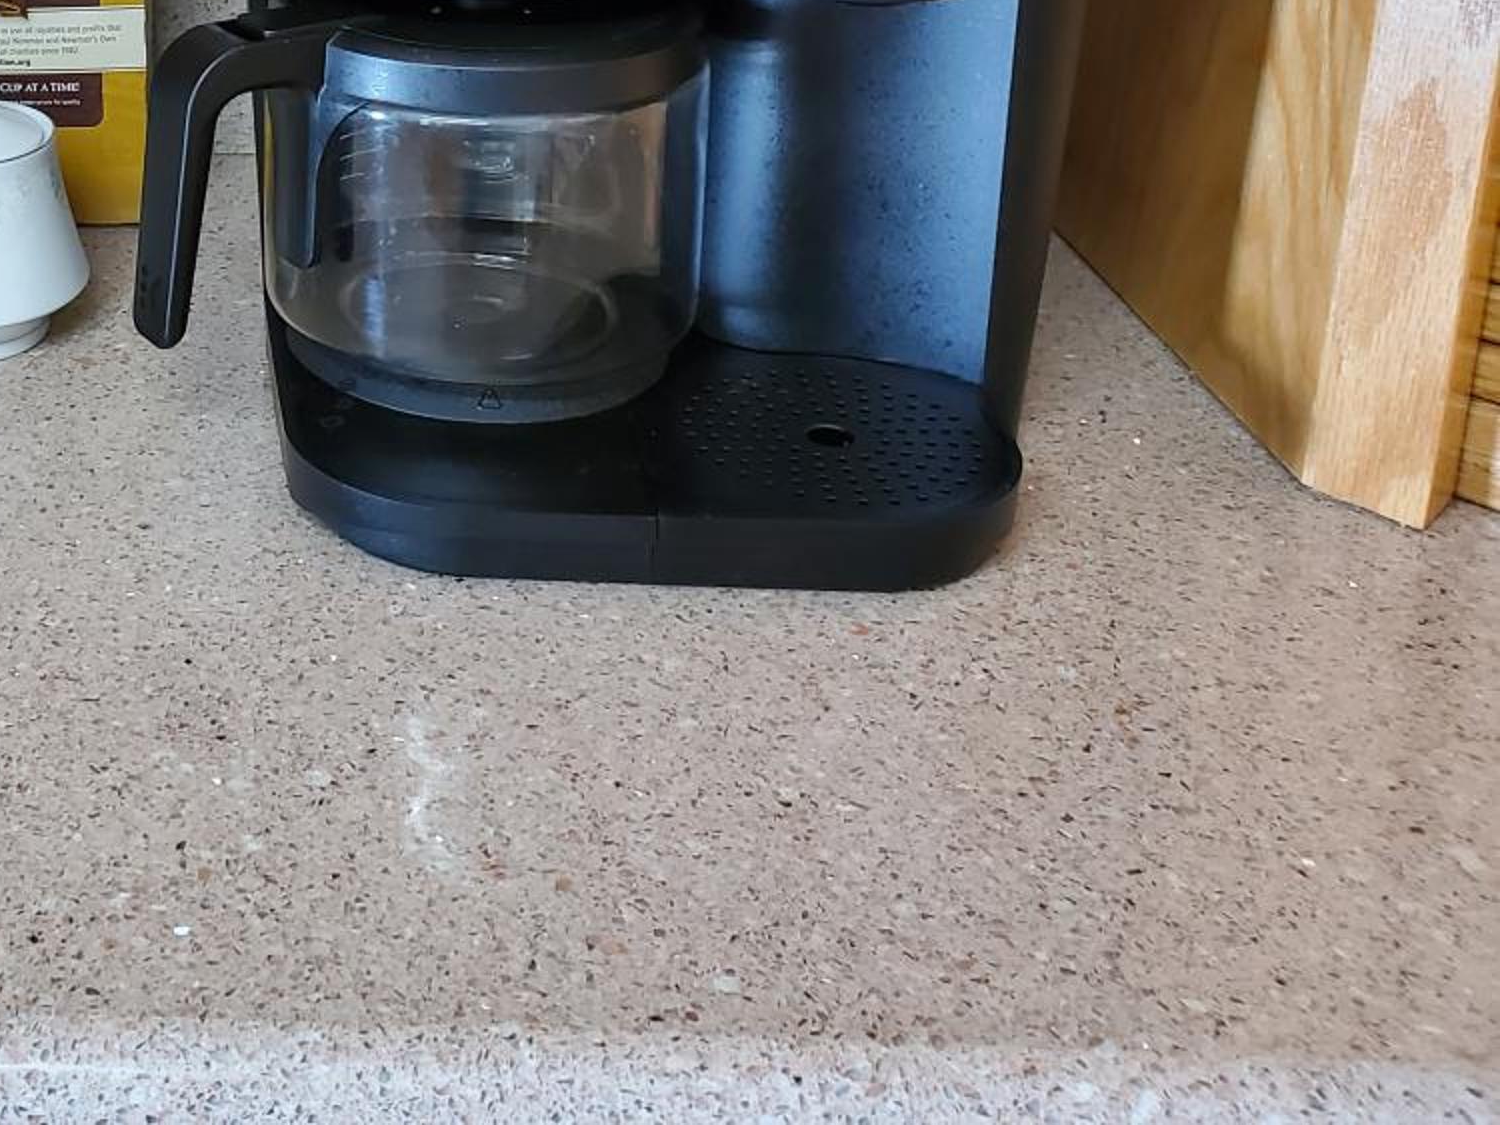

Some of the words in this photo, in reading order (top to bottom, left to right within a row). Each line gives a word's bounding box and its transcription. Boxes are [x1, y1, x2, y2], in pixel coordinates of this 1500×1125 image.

[0, 82, 23, 93] CUP
[24, 81, 39, 92] AT
[40, 81, 49, 92] A
